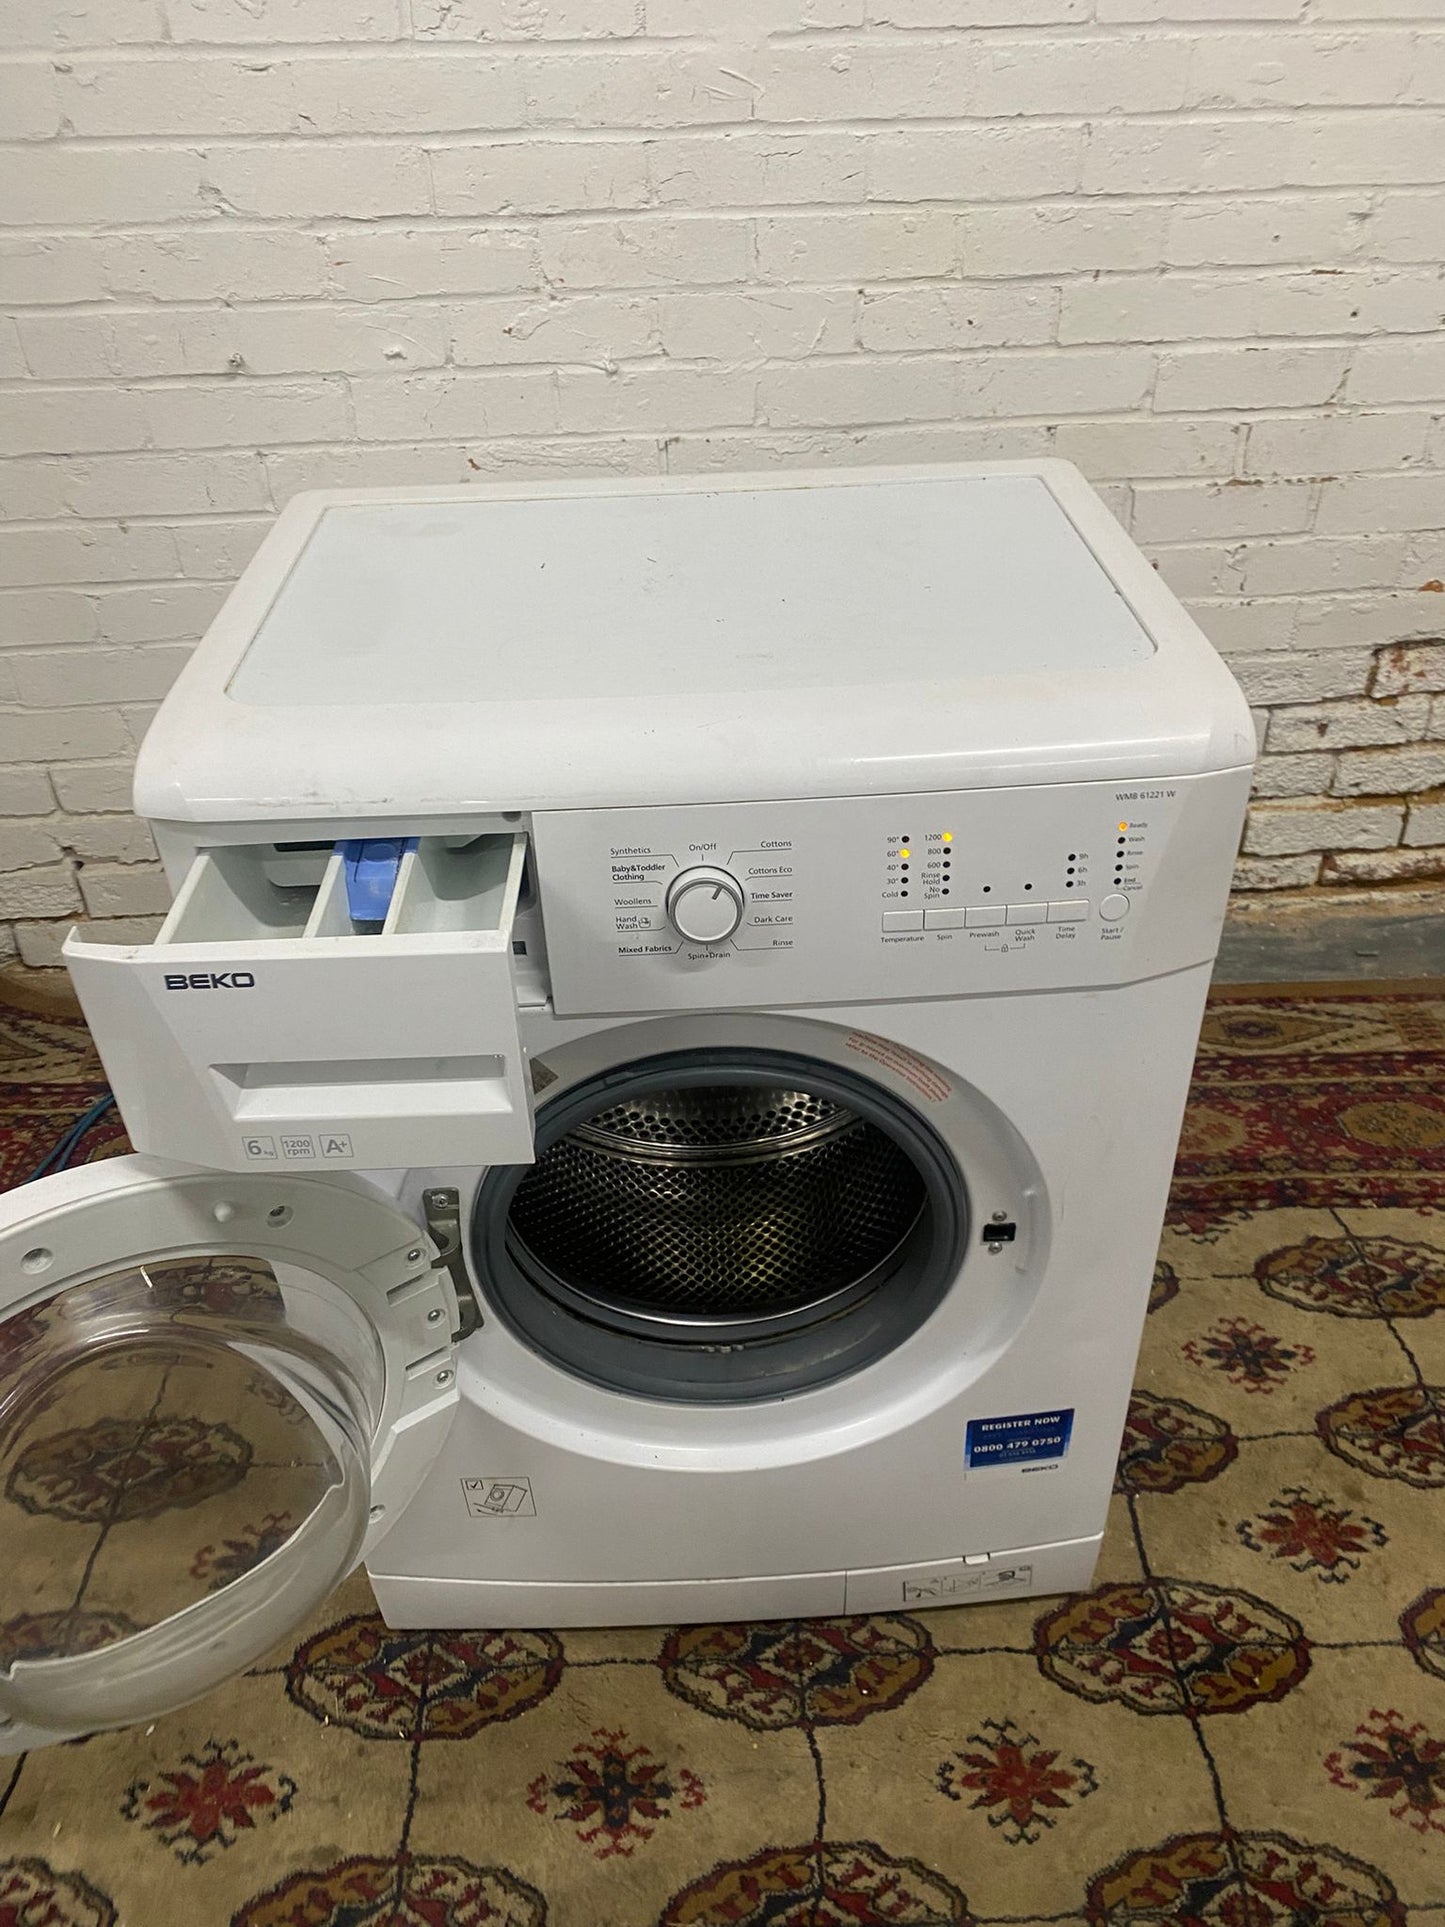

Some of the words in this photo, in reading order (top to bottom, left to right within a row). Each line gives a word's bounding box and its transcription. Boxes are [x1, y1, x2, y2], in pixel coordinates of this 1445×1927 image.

[760, 840, 792, 848] Cottons
[610, 847, 651, 855] Synthetics
[612, 864, 665, 874] Baby&Toddler
[612, 874, 644, 882] Clothing
[618, 946, 643, 954] Mixed
[164, 972, 255, 990] BEKO
[248, 1140, 261, 1155] 6
[284, 1140, 310, 1148] 1200
[288, 1148, 310, 1156] rpm
[982, 1420, 1031, 1431] REGISTER
[1034, 1416, 1060, 1425] NOW
[974, 1443, 1003, 1453] 0800
[1007, 1441, 1028, 1449] 479
[1032, 1436, 1061, 1446] 0750
